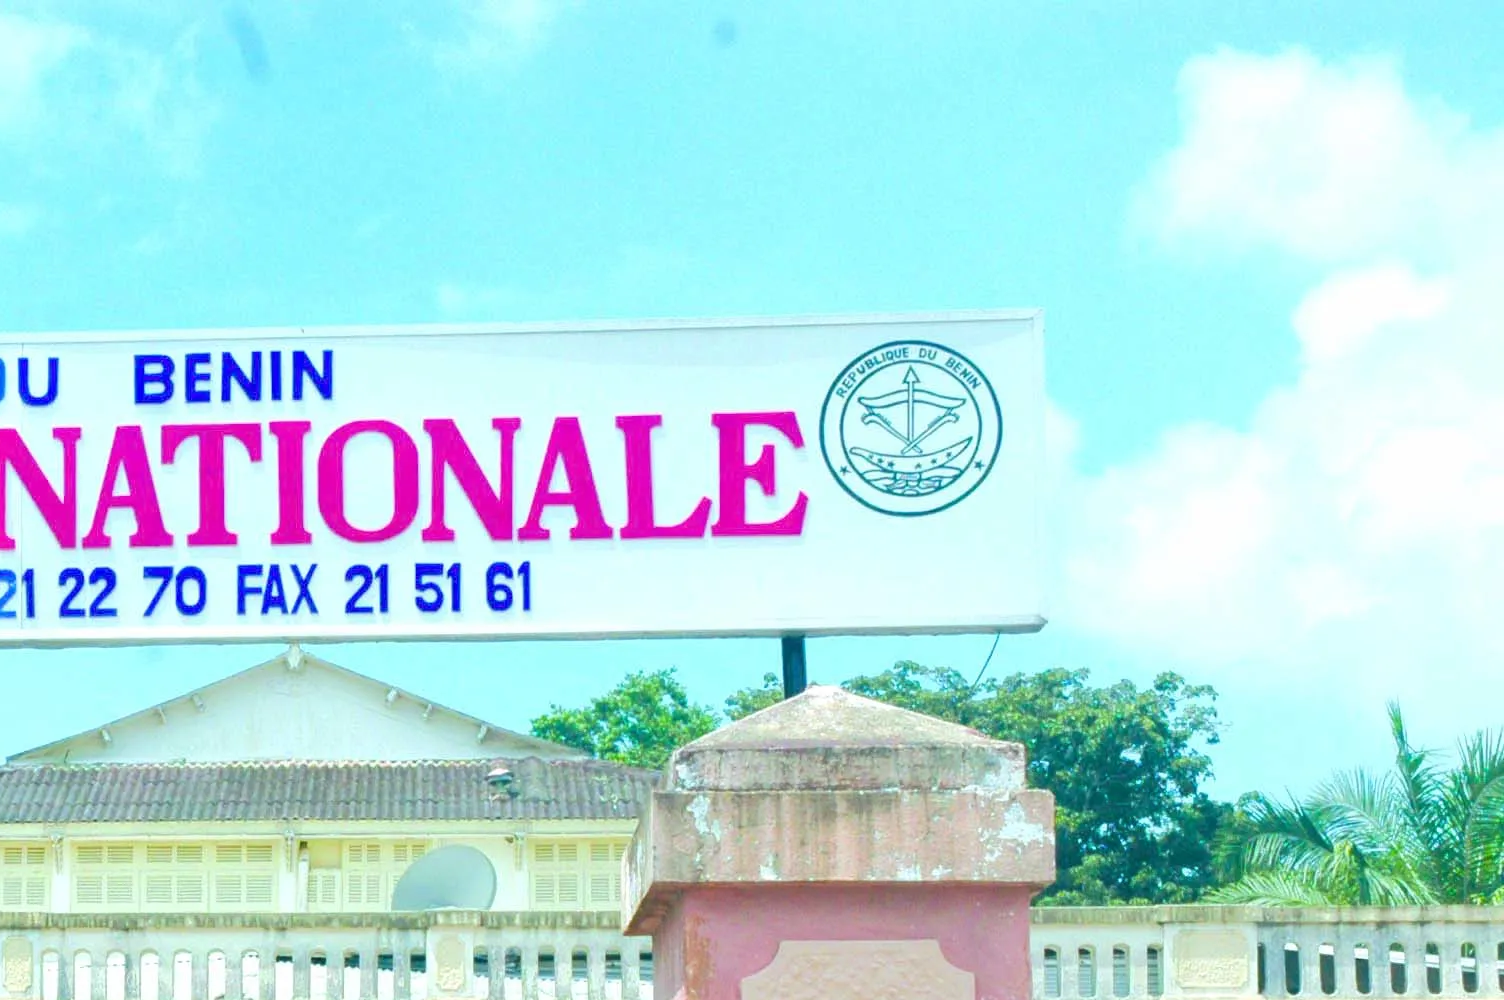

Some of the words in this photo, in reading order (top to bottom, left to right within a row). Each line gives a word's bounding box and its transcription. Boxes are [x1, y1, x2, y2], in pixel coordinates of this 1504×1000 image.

[134, 349, 334, 405] BENIN
[835, 347, 909, 398] REPUBLIQUE
[918, 348, 937, 360] DU
[945, 356, 982, 390] BENIN
[58, 566, 118, 618] 22
[143, 565, 208, 617] 70
[236, 563, 318, 616] FAX
[345, 563, 389, 615] 21
[414, 562, 462, 613] 51
[485, 560, 531, 613] 61
